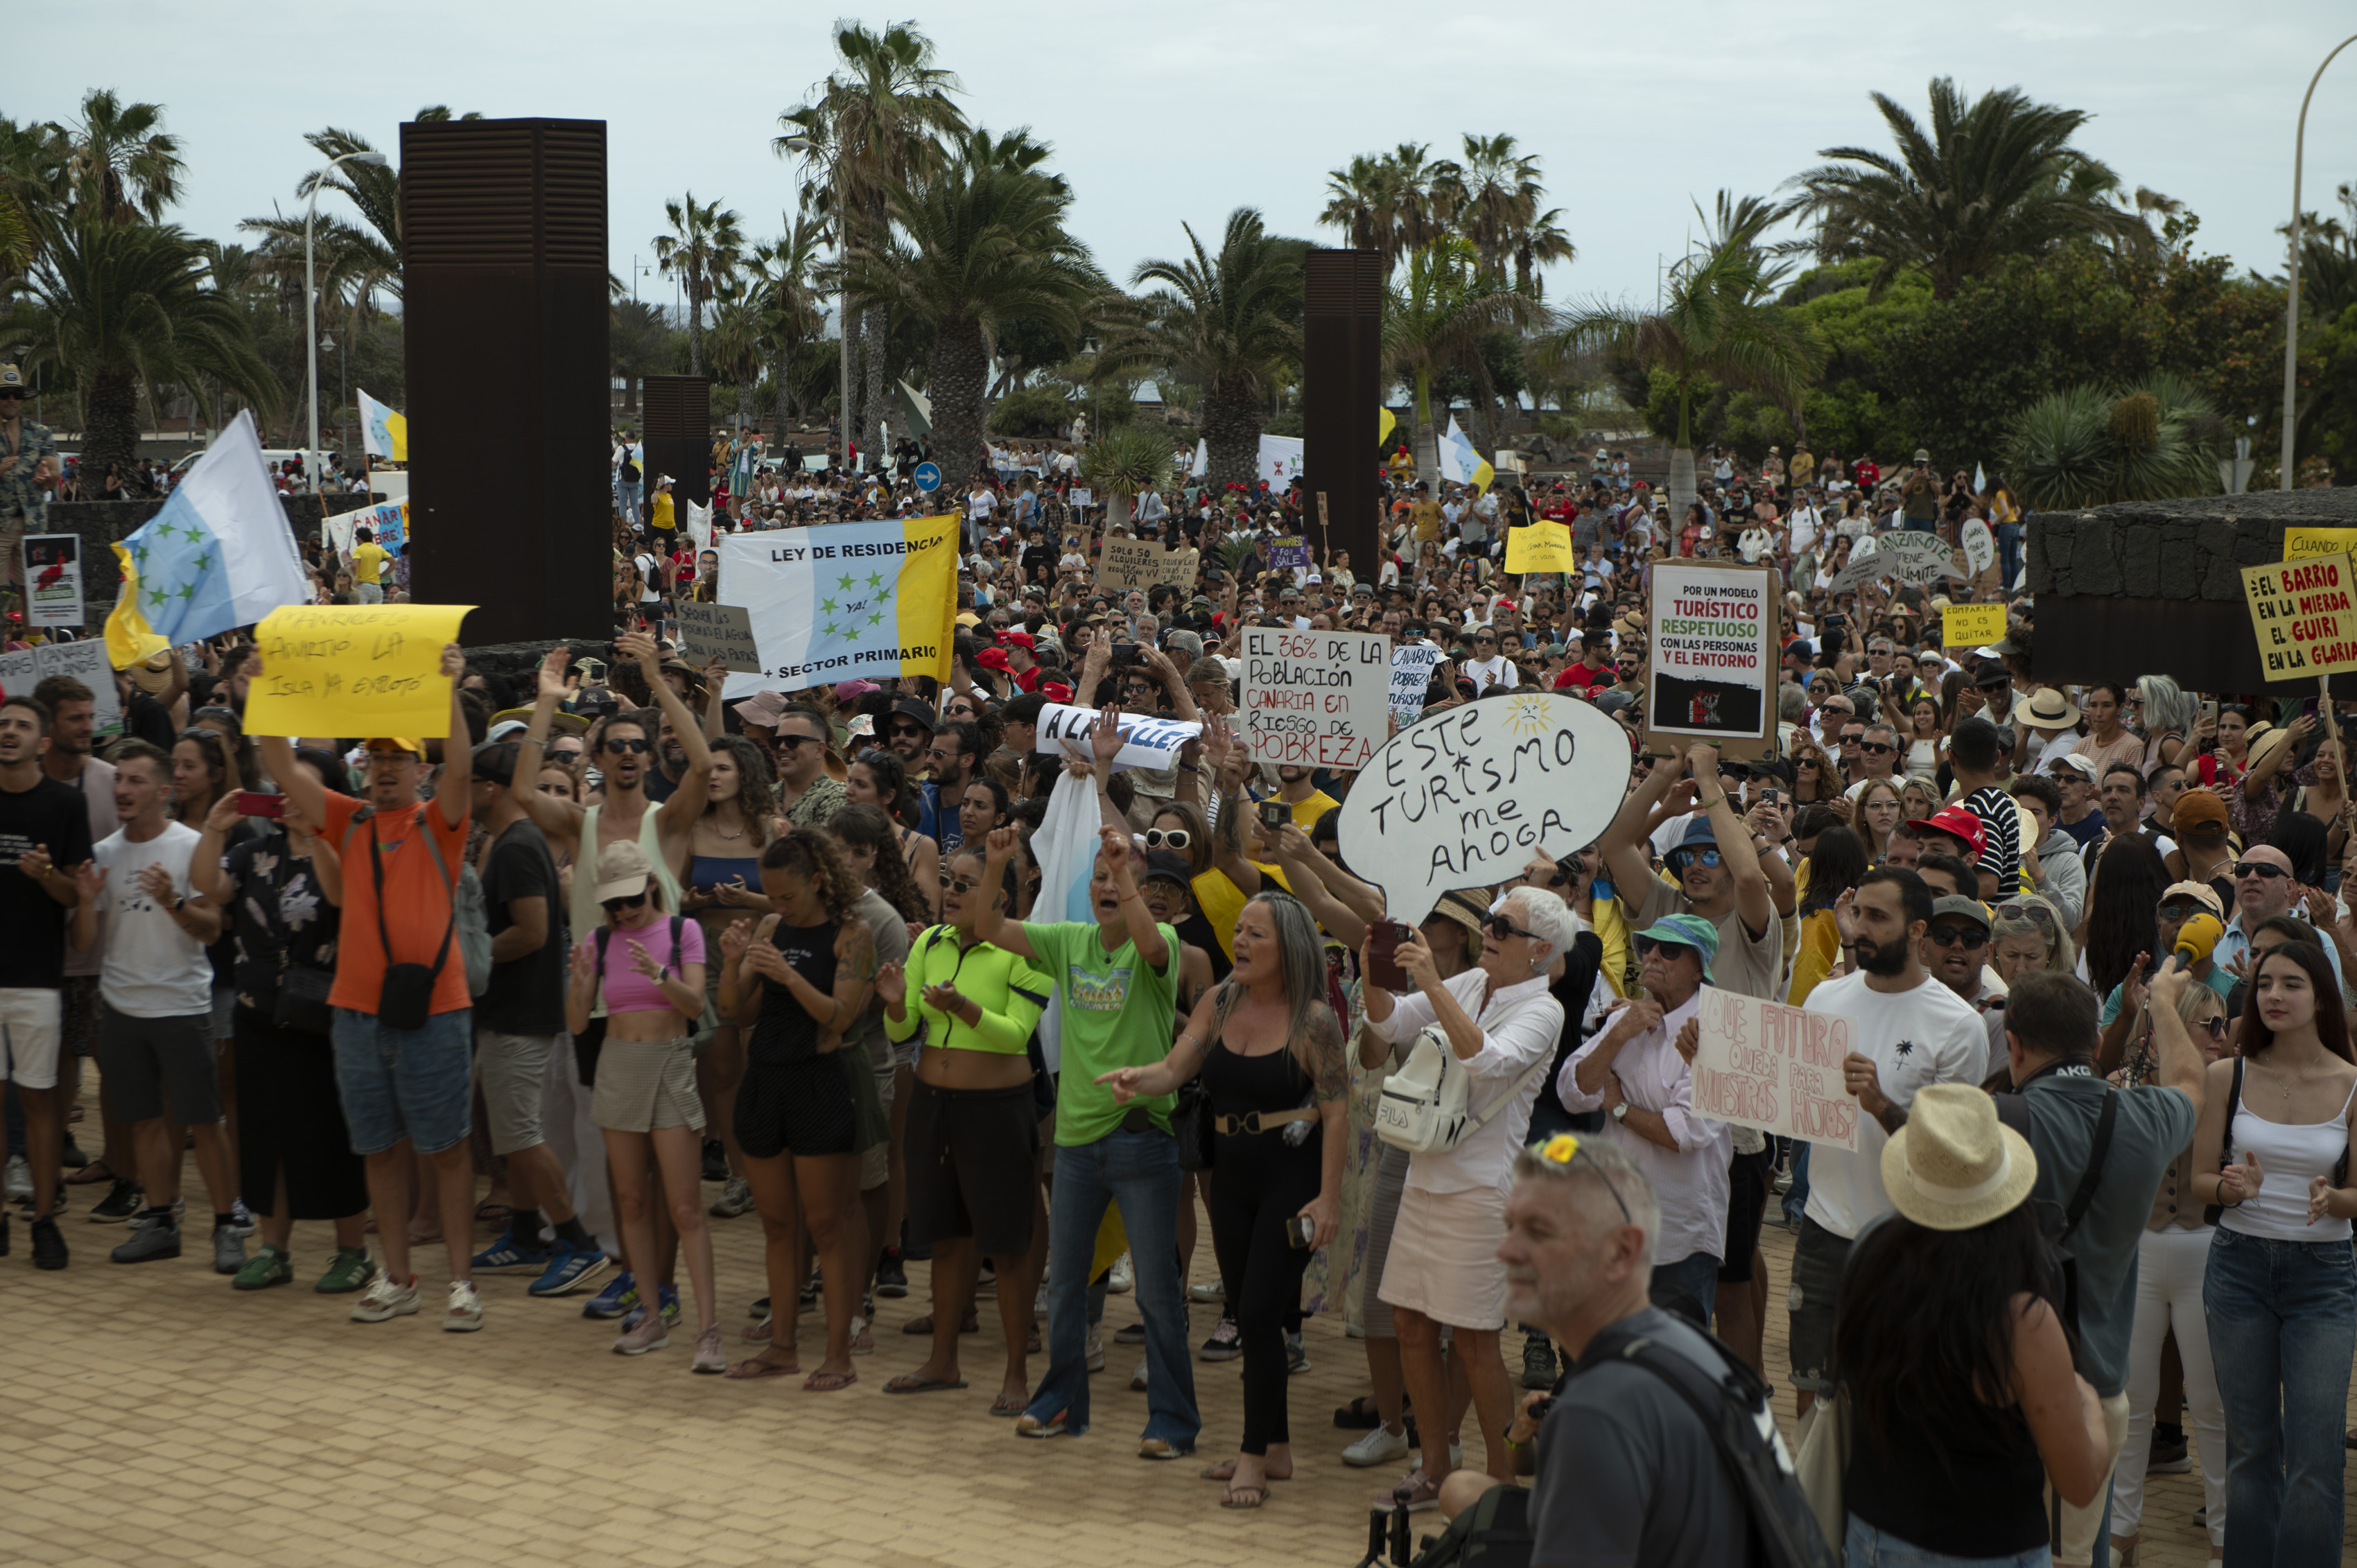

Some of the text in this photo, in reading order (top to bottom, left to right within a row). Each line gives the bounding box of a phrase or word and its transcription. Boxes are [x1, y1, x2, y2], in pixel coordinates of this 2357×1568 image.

[772, 535, 943, 562] LEY DE RESIDENCIA
[1271, 535, 1303, 548] CANARIES
[2292, 537, 2338, 552] CUANDO
[1110, 546, 1151, 558] SOLO 50
[1276, 555, 1301, 566] SALE
[1896, 551, 1925, 564] TIENE
[1108, 555, 1160, 567] ALQUILERES
[1163, 558, 1183, 566] EQUEN
[1107, 565, 1159, 578] REGULACIÓN VV
[1123, 574, 1137, 586] YA
[2259, 575, 2277, 597] EL
[2281, 560, 2339, 593] BARRIO
[1683, 585, 1758, 599] POR UN MODELO
[845, 600, 868, 614] YA!
[1673, 598, 1759, 620] TURÍSTICO
[1947, 605, 1998, 614] COMPARTIR
[2257, 591, 2351, 620] EN LA MIERDA
[1661, 618, 1758, 638] RESPETUOSO
[1977, 616, 1988, 625] ES
[713, 627, 724, 640] EL
[725, 629, 753, 641] AGUA
[1955, 629, 1993, 641] QUITAR
[2270, 616, 2339, 645] EL GUIRI
[371, 631, 406, 661] LA
[1249, 634, 1382, 665] EL 36% DE LA
[1660, 638, 1757, 653] CON LAS PERSONAS
[728, 647, 758, 664] PAPAS
[779, 655, 849, 679] SECTOR
[854, 645, 936, 664] PRIMARIO
[1391, 648, 1437, 666] CANARIAS
[1663, 650, 1757, 668] Y EL ENTORNO
[2268, 641, 2357, 670] EN LA GLORIA
[1391, 670, 1430, 687] POBREZA
[1247, 688, 1314, 712] CANARIA
[1388, 692, 1427, 706] TURISMO
[1045, 709, 1188, 753] A LA ALLE!
[1248, 710, 1353, 736] RIESGO DE
[1251, 729, 1372, 767] POBREZA
[1761, 1004, 1847, 1070] FUTURO
[1729, 1043, 1824, 1096] QUEDA PARA
[2055, 1065, 2091, 1077] AKG
[1696, 1064, 1858, 1149] NUESTROS HIJOS?
[1378, 1104, 1409, 1129] FILA
